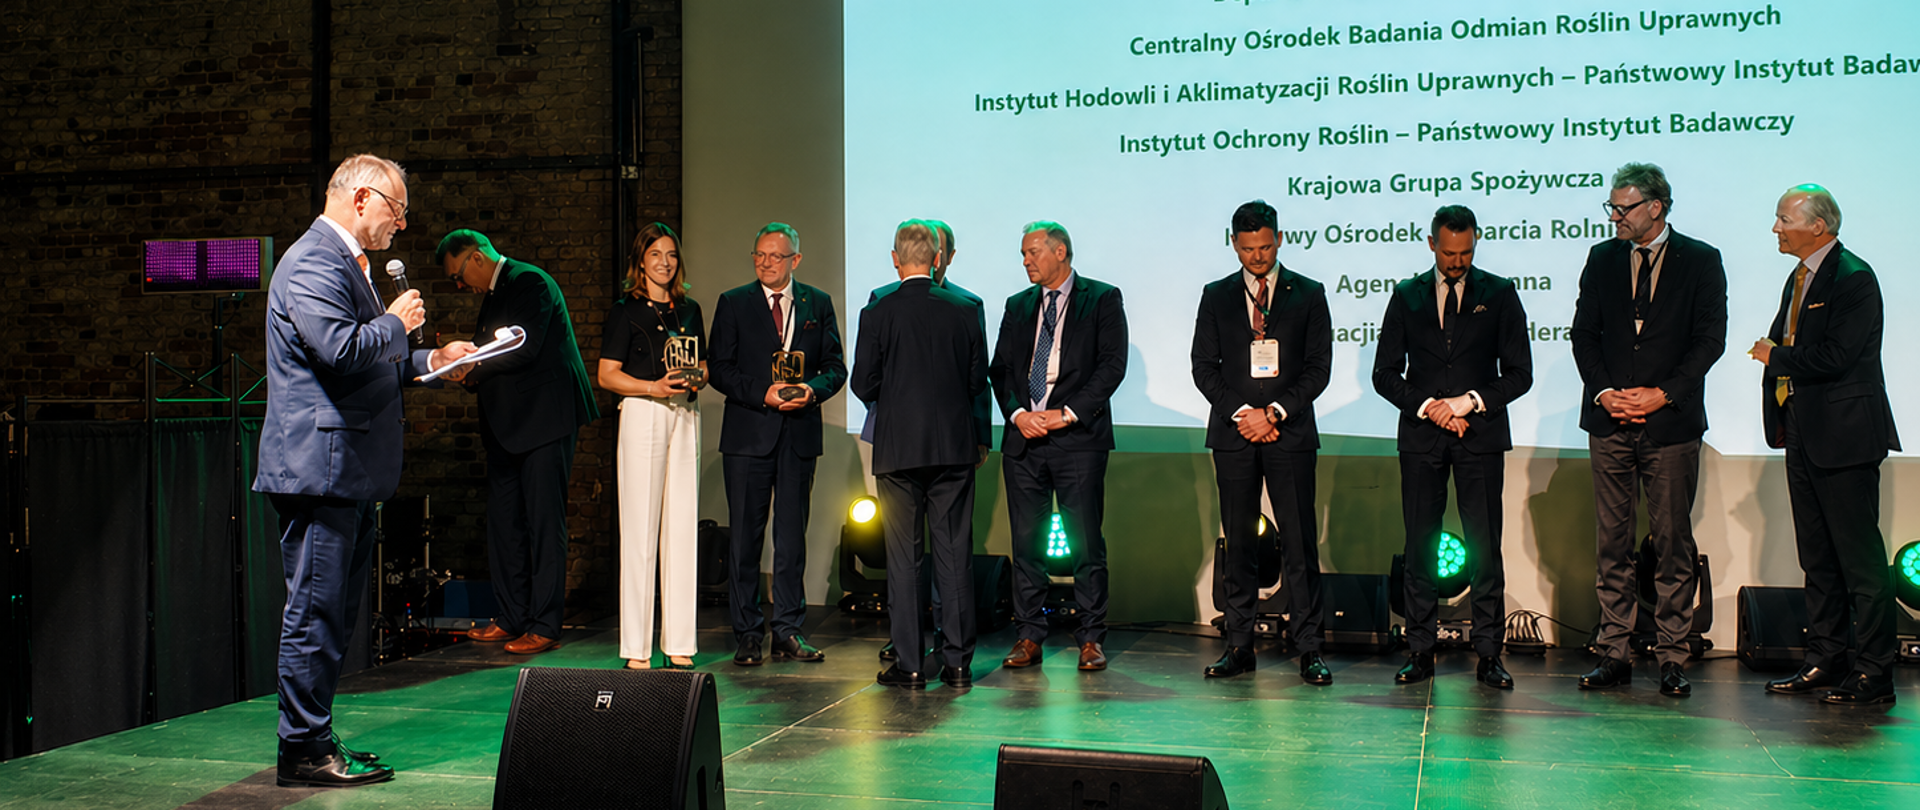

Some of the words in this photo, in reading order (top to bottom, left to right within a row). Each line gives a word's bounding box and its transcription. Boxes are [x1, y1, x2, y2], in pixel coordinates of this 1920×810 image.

[1130, 33, 1237, 56] Centralny
[1244, 25, 1341, 50] Ośrodek
[1349, 21, 1443, 44] Badania
[1451, 16, 1547, 40] Odmian
[1557, 12, 1631, 35] Roślin
[1640, 4, 1782, 36] Uprawnych
[975, 92, 1059, 115] Instytut
[1066, 84, 1156, 108] Hodowli
[1163, 84, 1169, 104] i
[1177, 76, 1329, 105] Aklimatyzacji
[1339, 73, 1409, 96] Roślin
[1418, 66, 1554, 97] Uprawnych
[1585, 62, 1726, 87] Państwowy
[1735, 58, 1835, 83] Instytut
[1120, 134, 1206, 157] Instytut
[1214, 128, 1311, 152] Ochrony
[1319, 124, 1389, 147] Roślin
[1418, 119, 1555, 144] Państwowy
[1564, 116, 1662, 141] Instytut
[1670, 111, 1795, 137] Badawczy
[1288, 174, 1382, 200] Krajowa
[1390, 173, 1462, 198] Grupa
[1471, 169, 1604, 196] Spożywcza
[1325, 222, 1423, 244] Ośrodek
